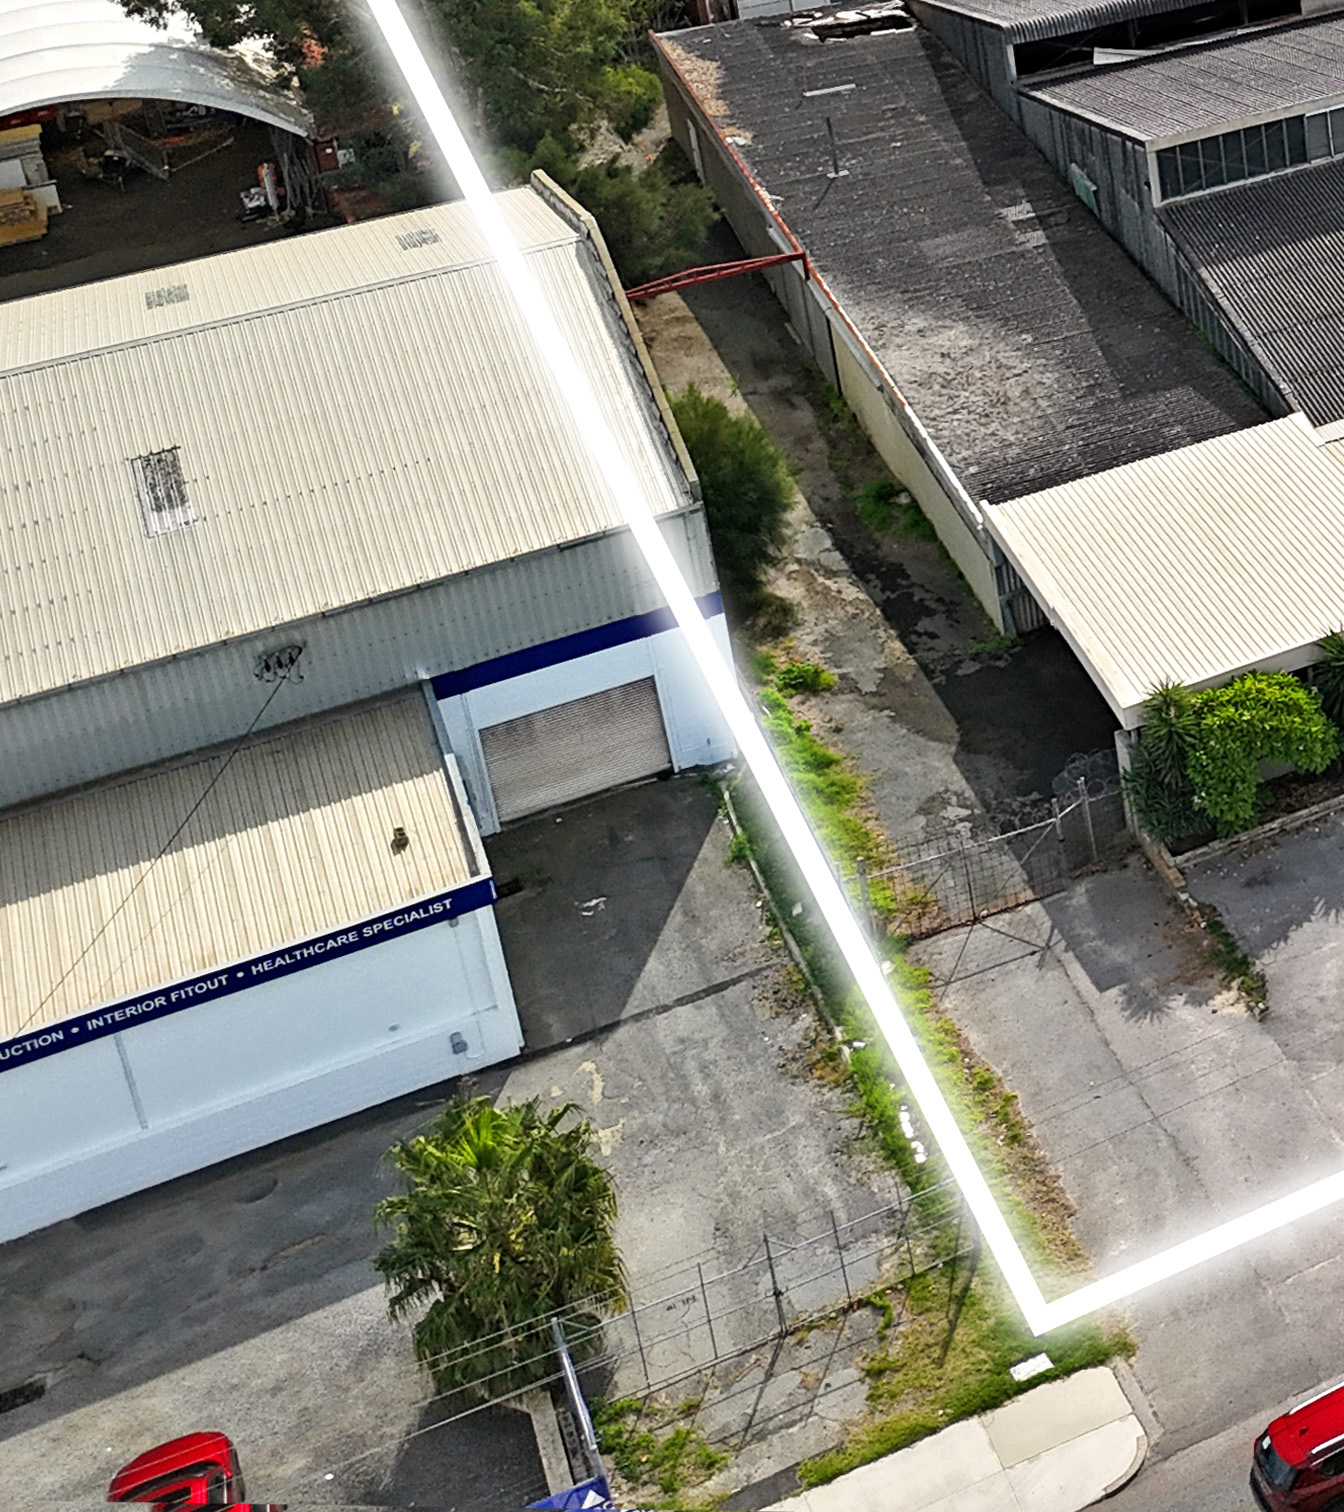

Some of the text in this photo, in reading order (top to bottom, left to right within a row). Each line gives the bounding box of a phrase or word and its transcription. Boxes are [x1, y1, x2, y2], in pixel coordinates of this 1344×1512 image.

[0, 898, 453, 1060] UCTION INTERIOR FITOUT HEALTHCARE SPECIALIST
